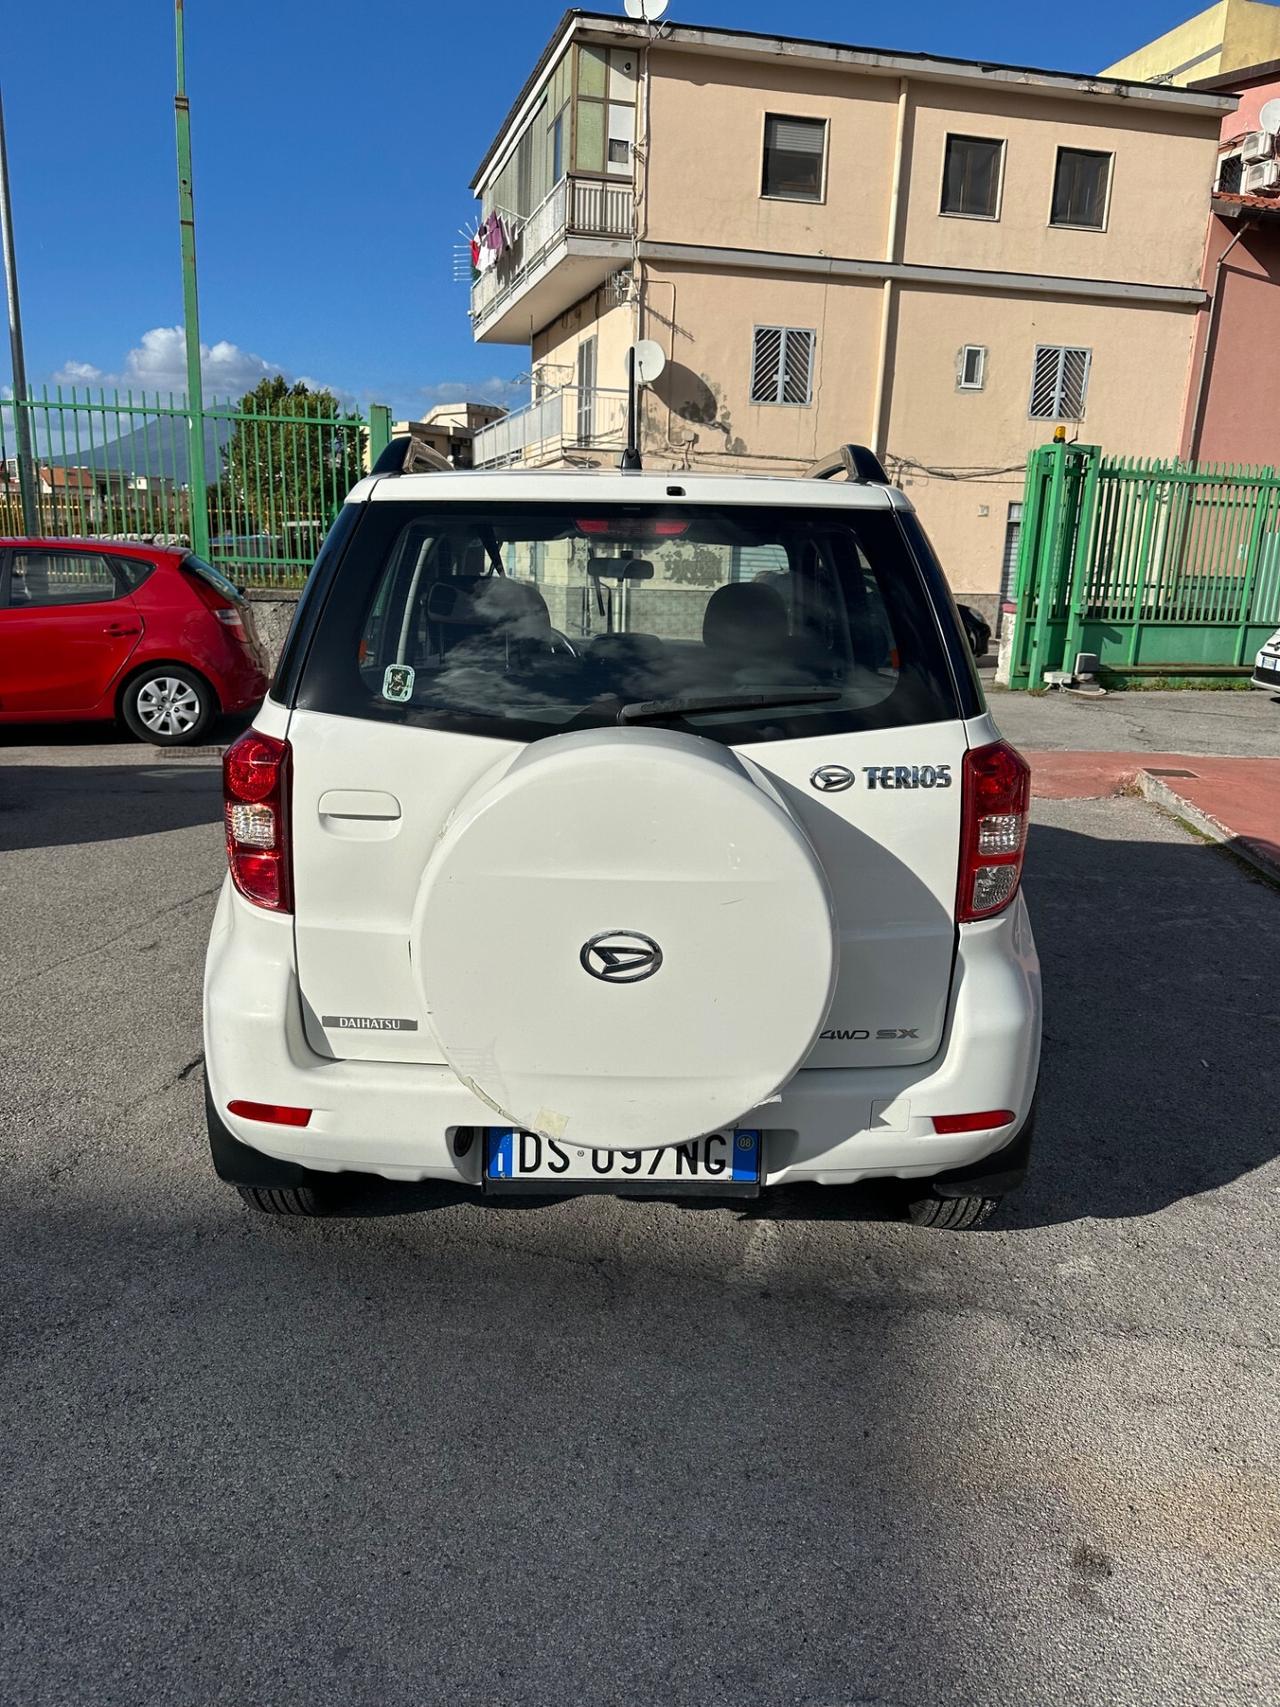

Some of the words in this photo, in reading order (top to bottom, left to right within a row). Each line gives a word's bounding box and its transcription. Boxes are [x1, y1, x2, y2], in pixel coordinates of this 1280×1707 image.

[861, 764, 952, 790] TERIOS
[339, 1017, 401, 1030] DAIHATSU
[818, 1029, 870, 1040] 4WD
[875, 1028, 920, 1039] SX
